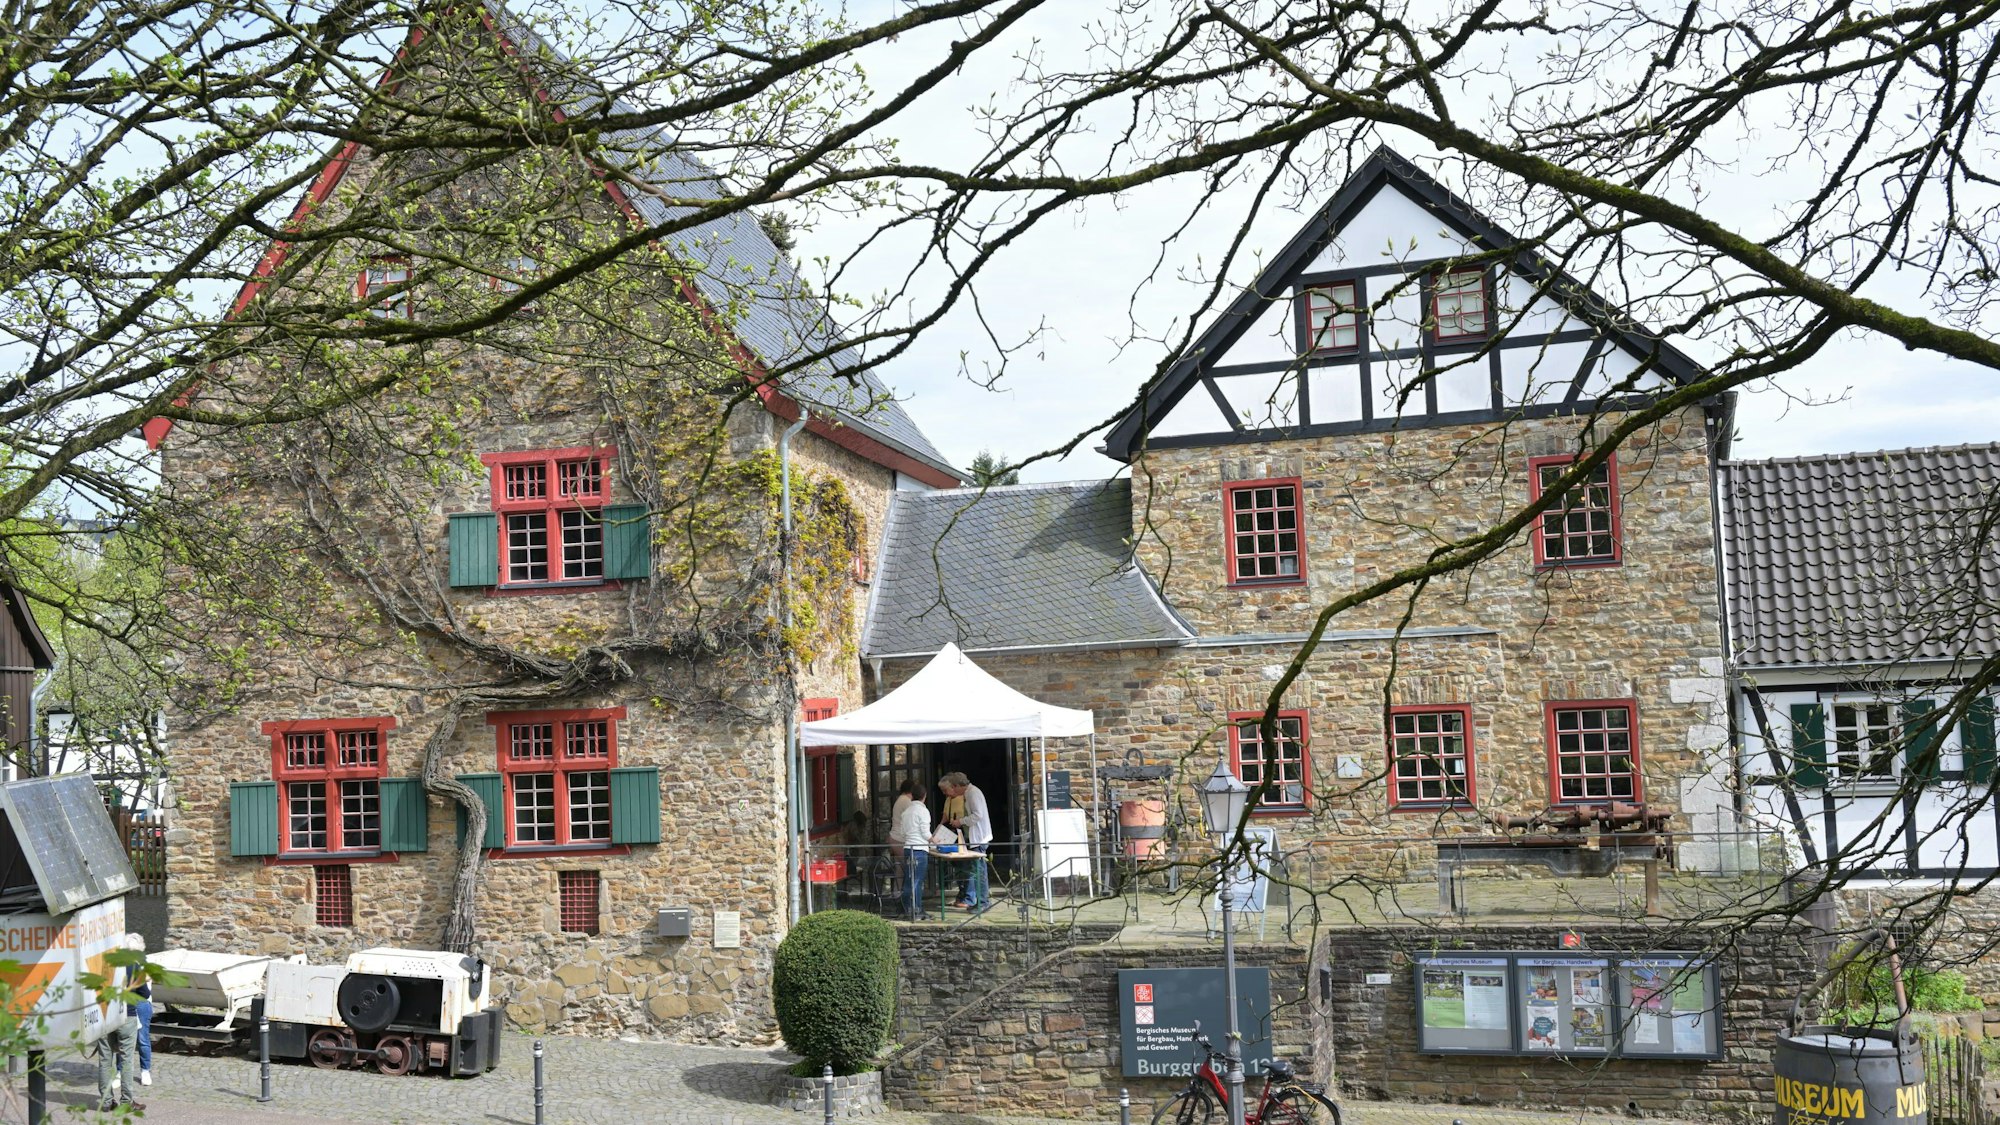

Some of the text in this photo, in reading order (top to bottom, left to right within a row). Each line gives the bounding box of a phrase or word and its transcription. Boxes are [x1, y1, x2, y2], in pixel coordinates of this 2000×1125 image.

[1136, 1027, 1169, 1035] Bergisches
[1147, 1035, 1175, 1043] Bergbau,
[1774, 1072, 1865, 1118] MUSEUM
